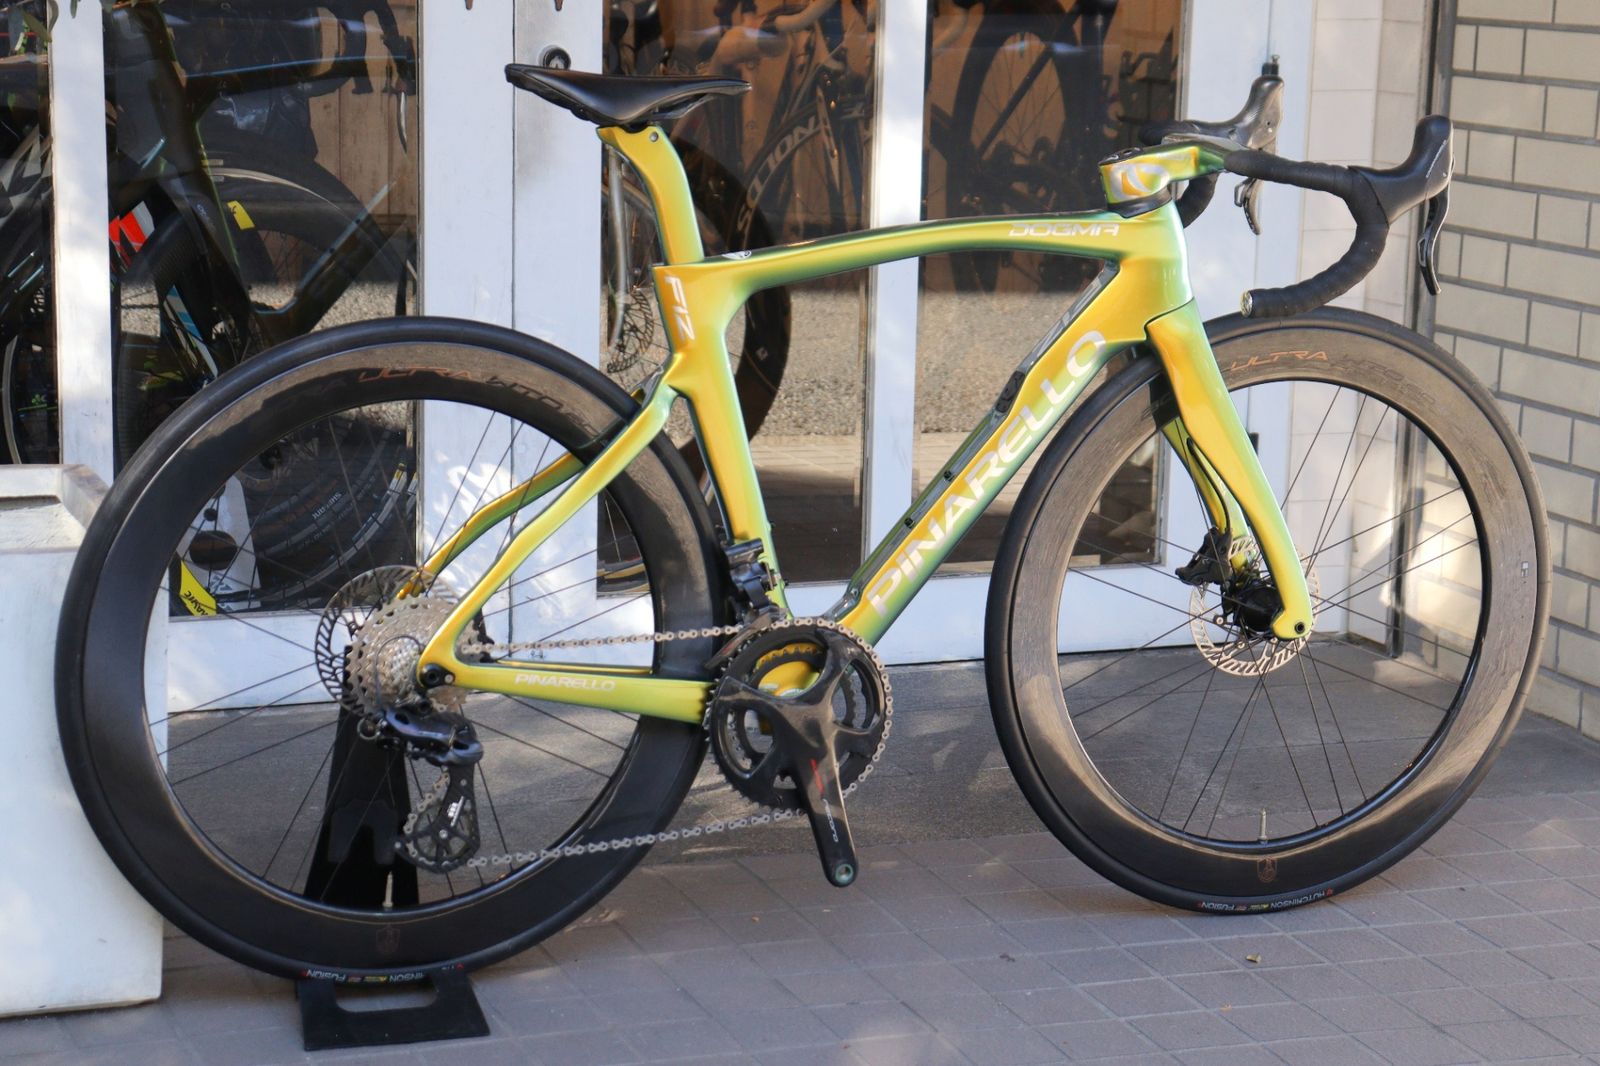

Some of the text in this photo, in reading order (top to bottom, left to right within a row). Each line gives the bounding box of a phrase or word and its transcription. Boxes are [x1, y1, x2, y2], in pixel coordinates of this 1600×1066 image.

[1008, 222, 1120, 237] DOGMA
[1230, 350, 1329, 372] ULTRA
[358, 365, 472, 382] ULTRA
[867, 330, 1106, 617] PINARELLO
[514, 673, 617, 692] PINARELLO
[1201, 901, 1235, 911] FUSION
[1270, 890, 1325, 909] HUTCHINSON
